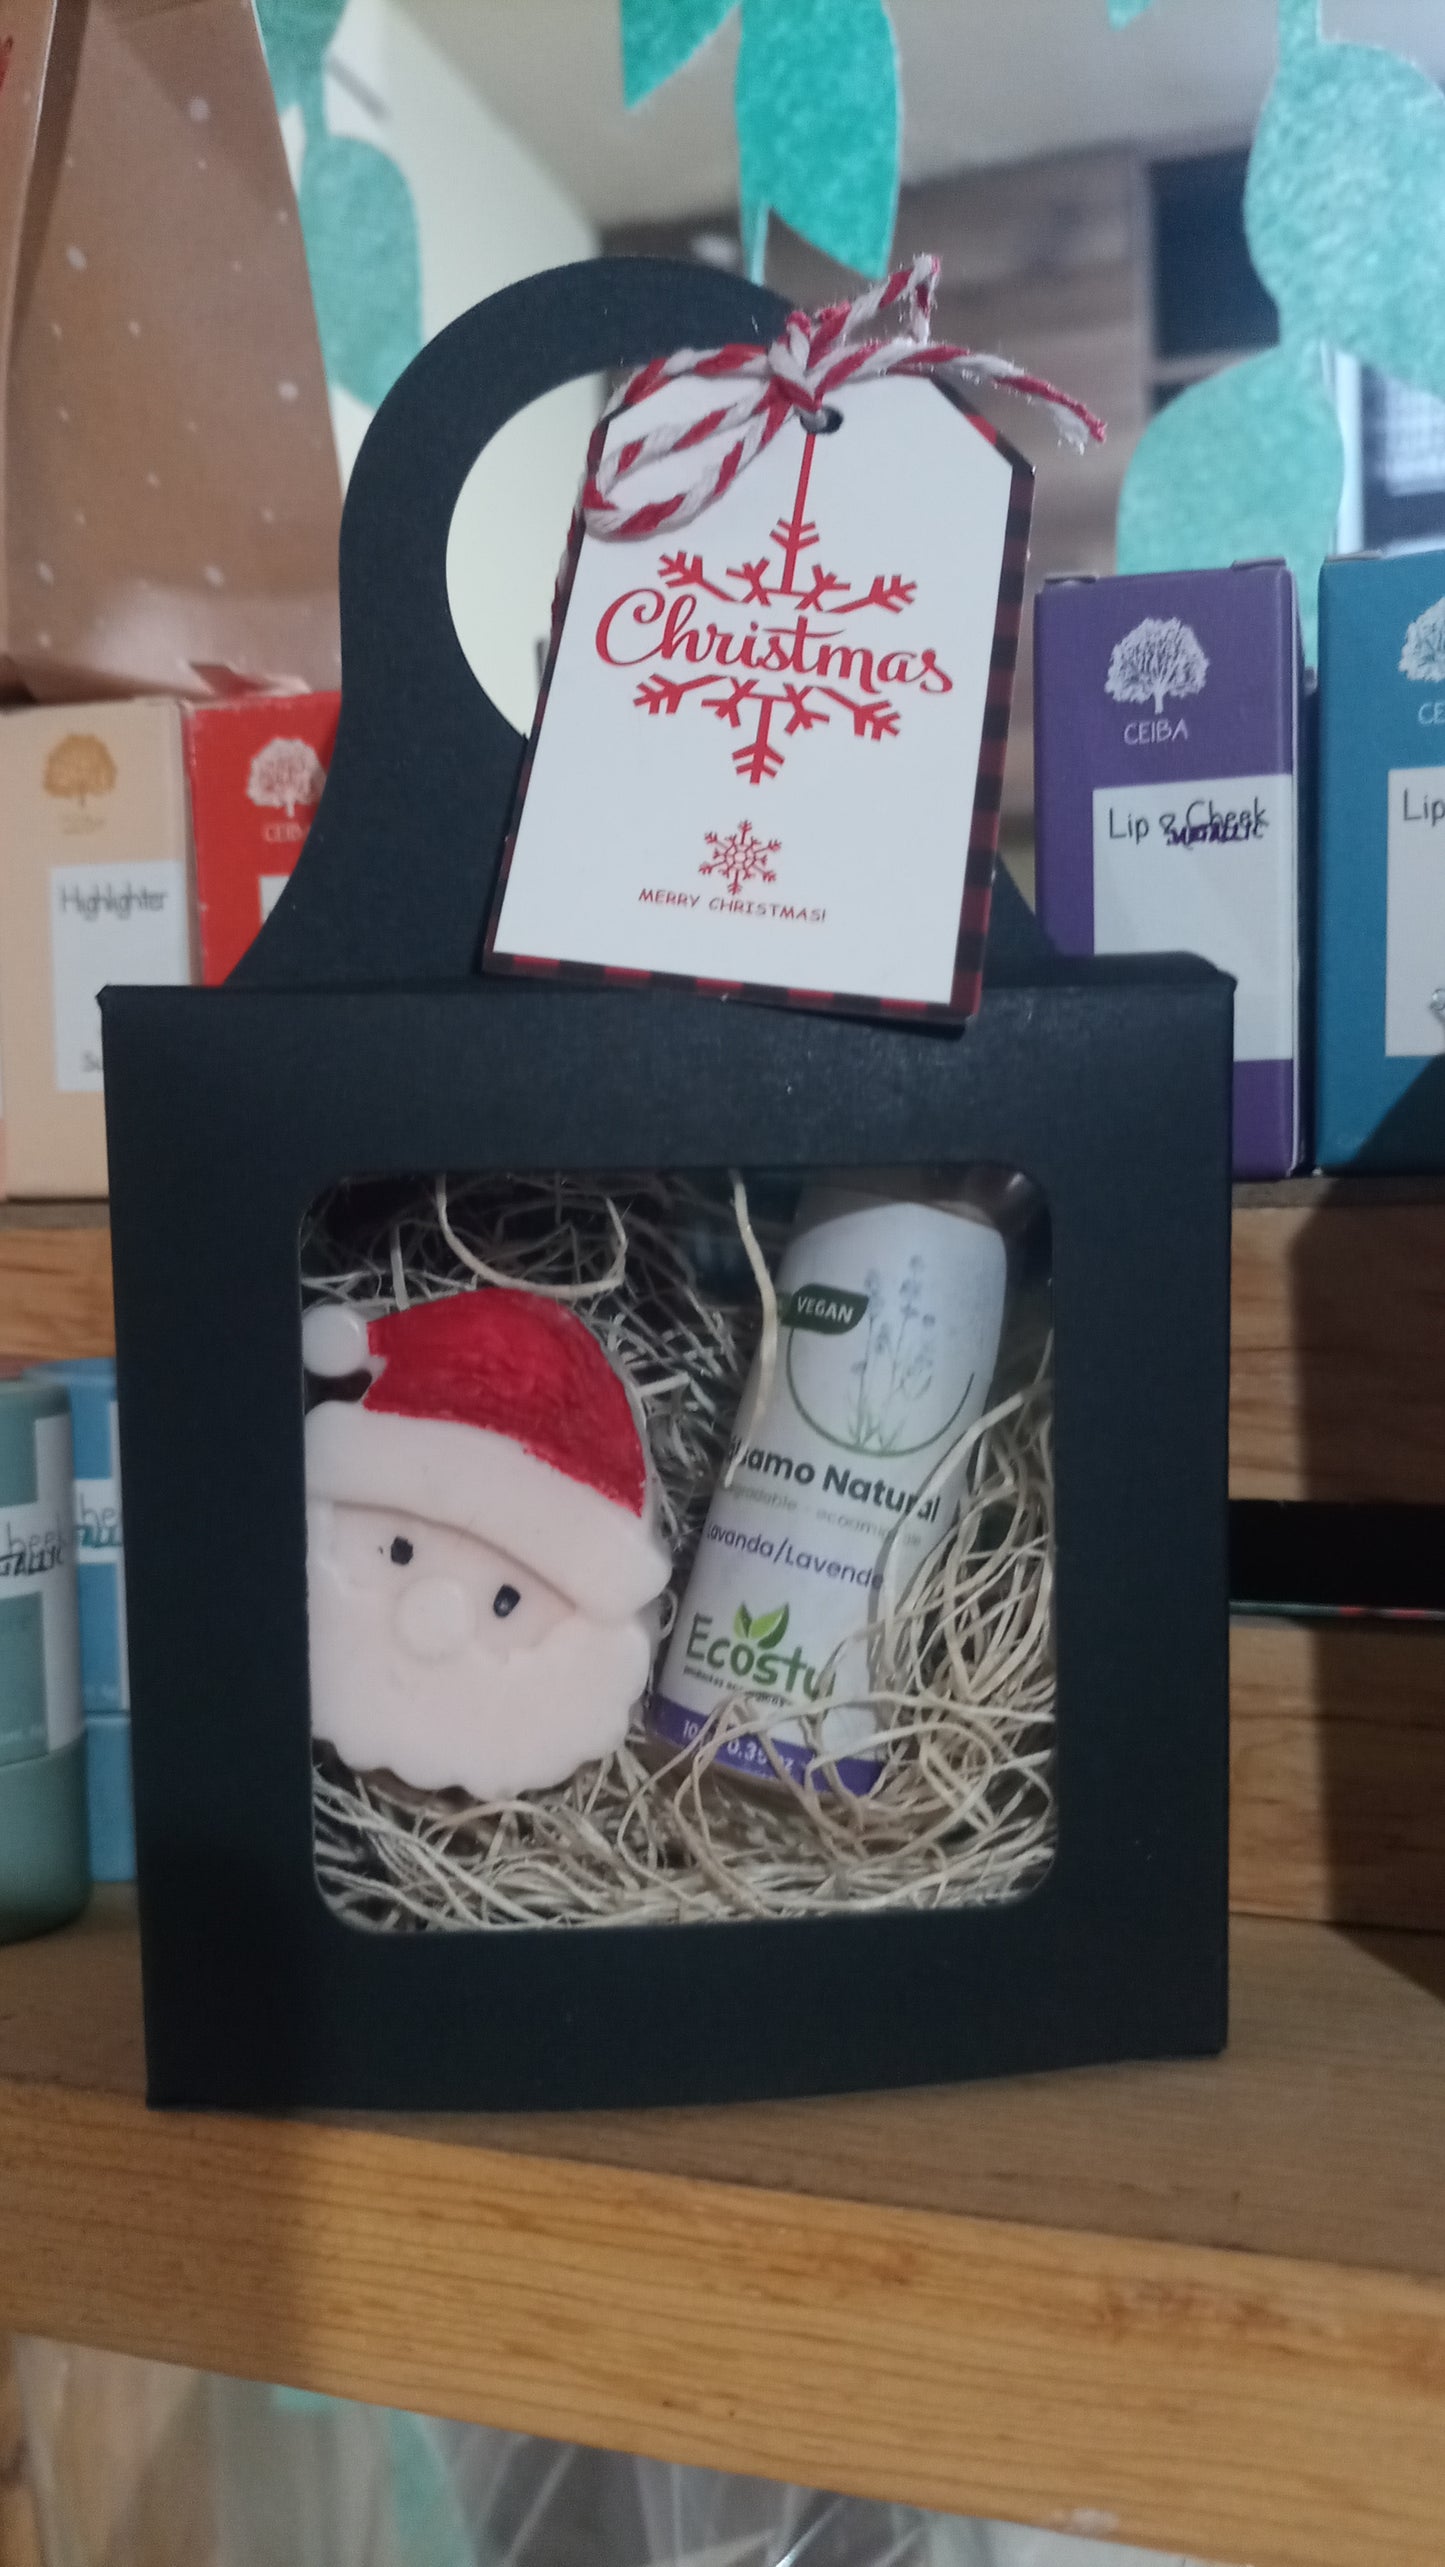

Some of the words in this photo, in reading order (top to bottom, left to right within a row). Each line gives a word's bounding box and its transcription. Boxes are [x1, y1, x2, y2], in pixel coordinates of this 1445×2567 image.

[596, 588, 953, 694] Christmas
[1123, 718, 1189, 745] CEIBA
[1109, 807, 1150, 845] Lip
[638, 888, 701, 908] MERRY
[708, 897, 826, 922] CHRISTMAS!
[797, 1296, 854, 1324] VEGAN
